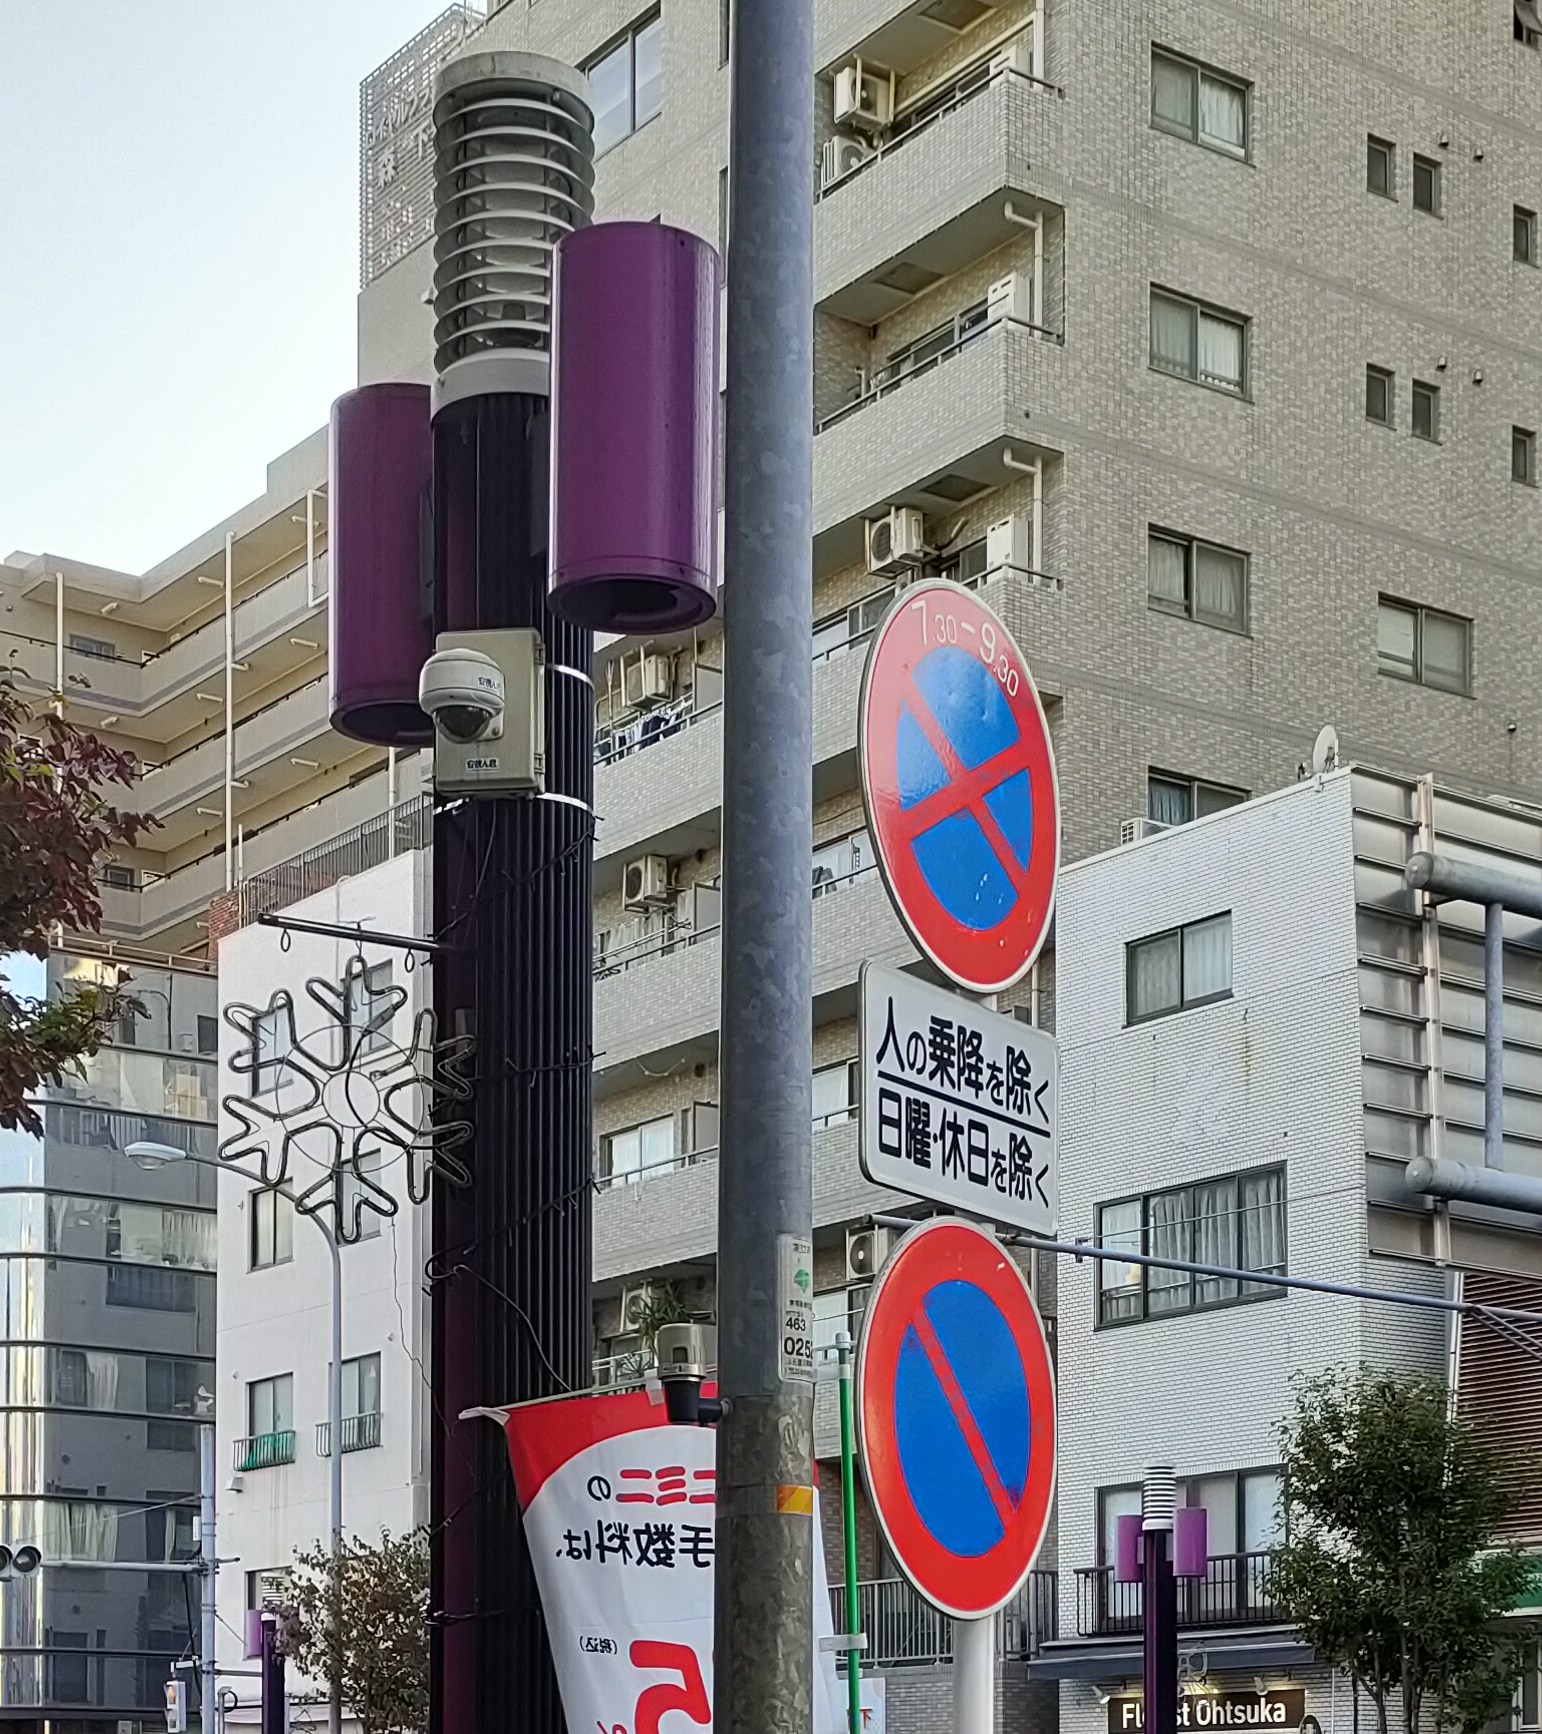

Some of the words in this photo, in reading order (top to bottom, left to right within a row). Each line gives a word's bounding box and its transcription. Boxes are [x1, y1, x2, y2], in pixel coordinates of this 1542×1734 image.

[875, 996, 1051, 1126] 人の乗降を除く
[877, 1088, 1051, 1209] 日曜・休日を除く
[786, 1316, 806, 1331] 463
[1196, 1696, 1287, 1726] Ohtsuka
